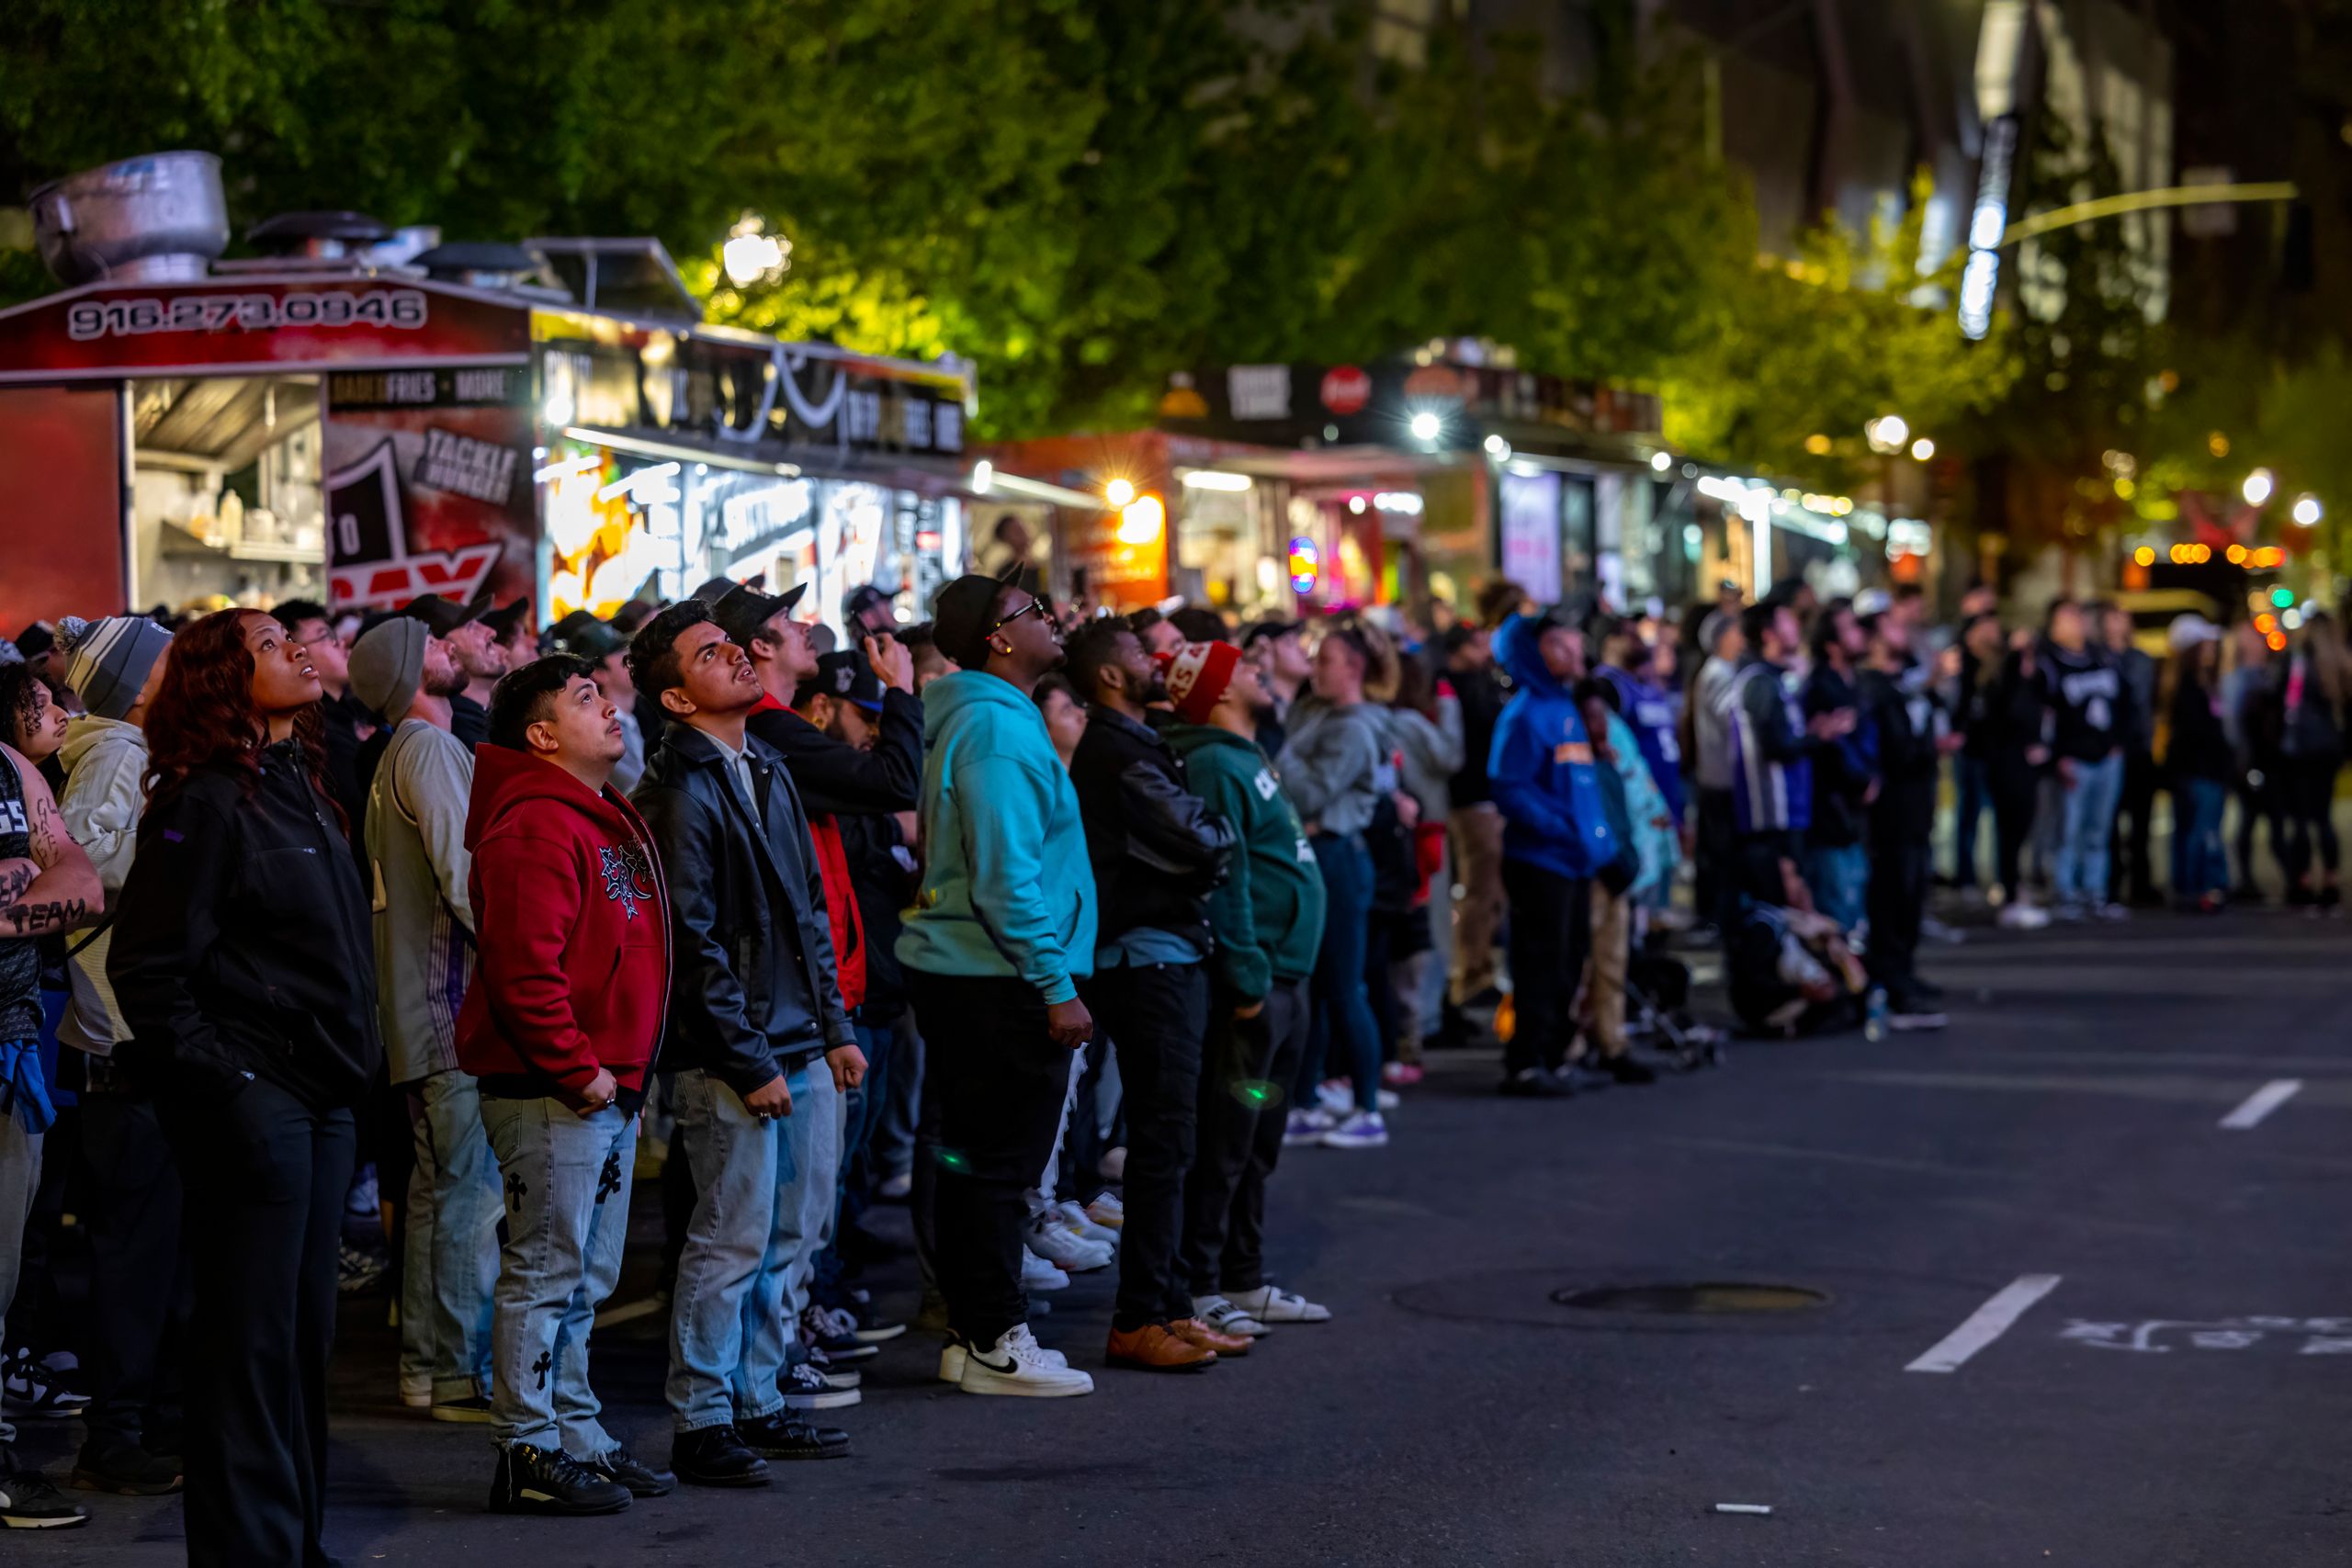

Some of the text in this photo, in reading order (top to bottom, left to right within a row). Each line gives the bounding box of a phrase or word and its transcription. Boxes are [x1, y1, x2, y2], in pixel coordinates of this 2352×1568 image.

[70, 290, 426, 340] 916.273.0946
[426, 427, 518, 474] TACKLE
[6, 897, 85, 934] TEAM
